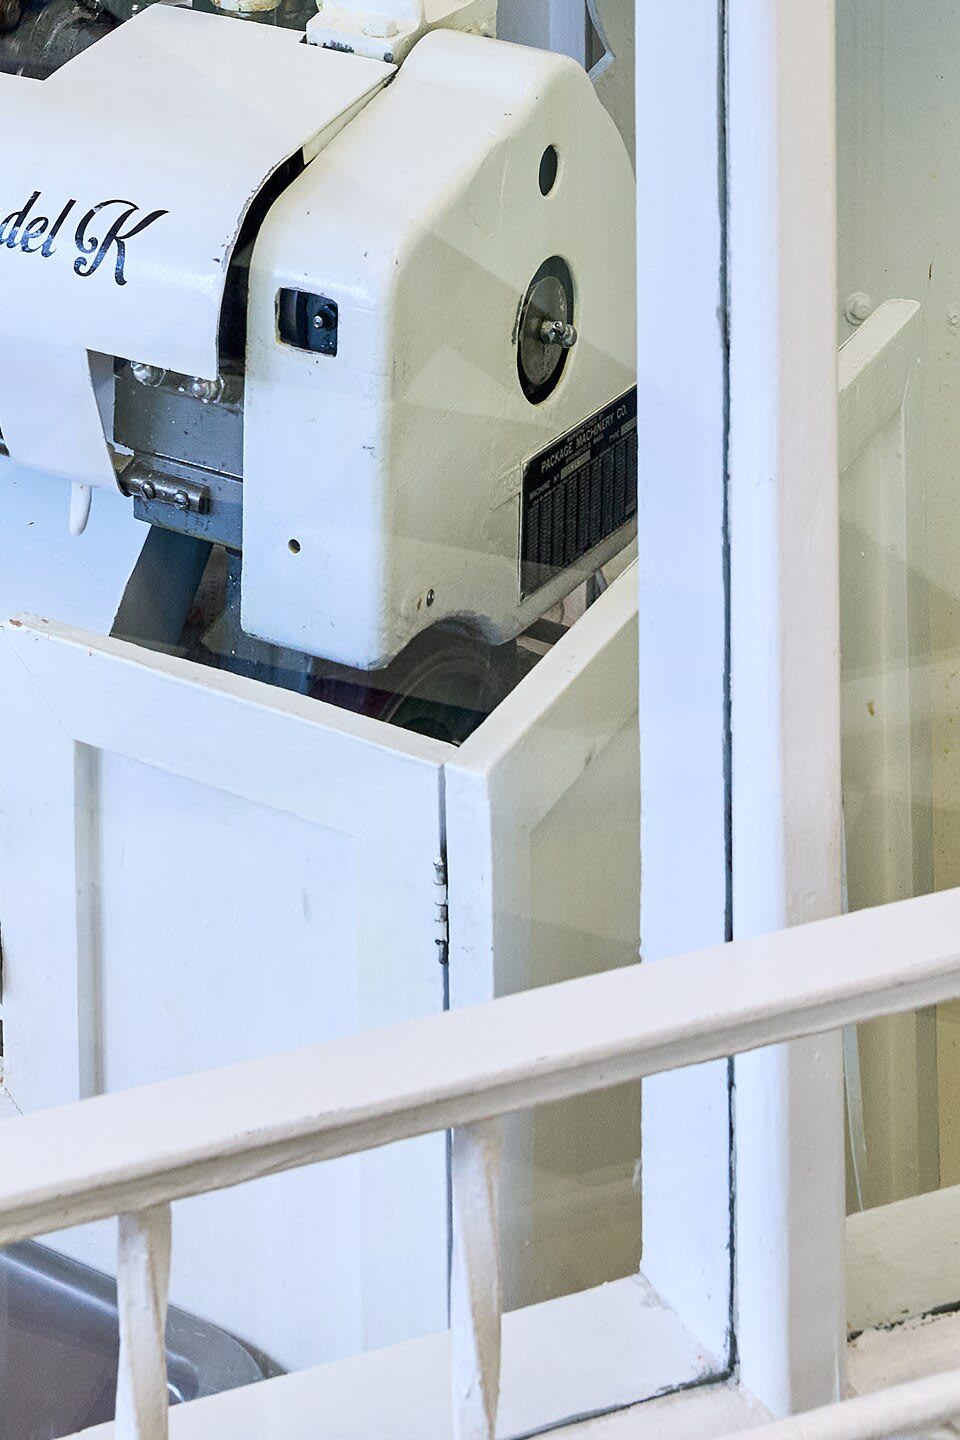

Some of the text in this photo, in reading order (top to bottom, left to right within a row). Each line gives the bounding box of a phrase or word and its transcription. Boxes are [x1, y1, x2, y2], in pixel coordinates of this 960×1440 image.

[73, 199, 170, 286] K
[540, 441, 573, 474] PACKAGE
[575, 412, 615, 449] MACHINERY
